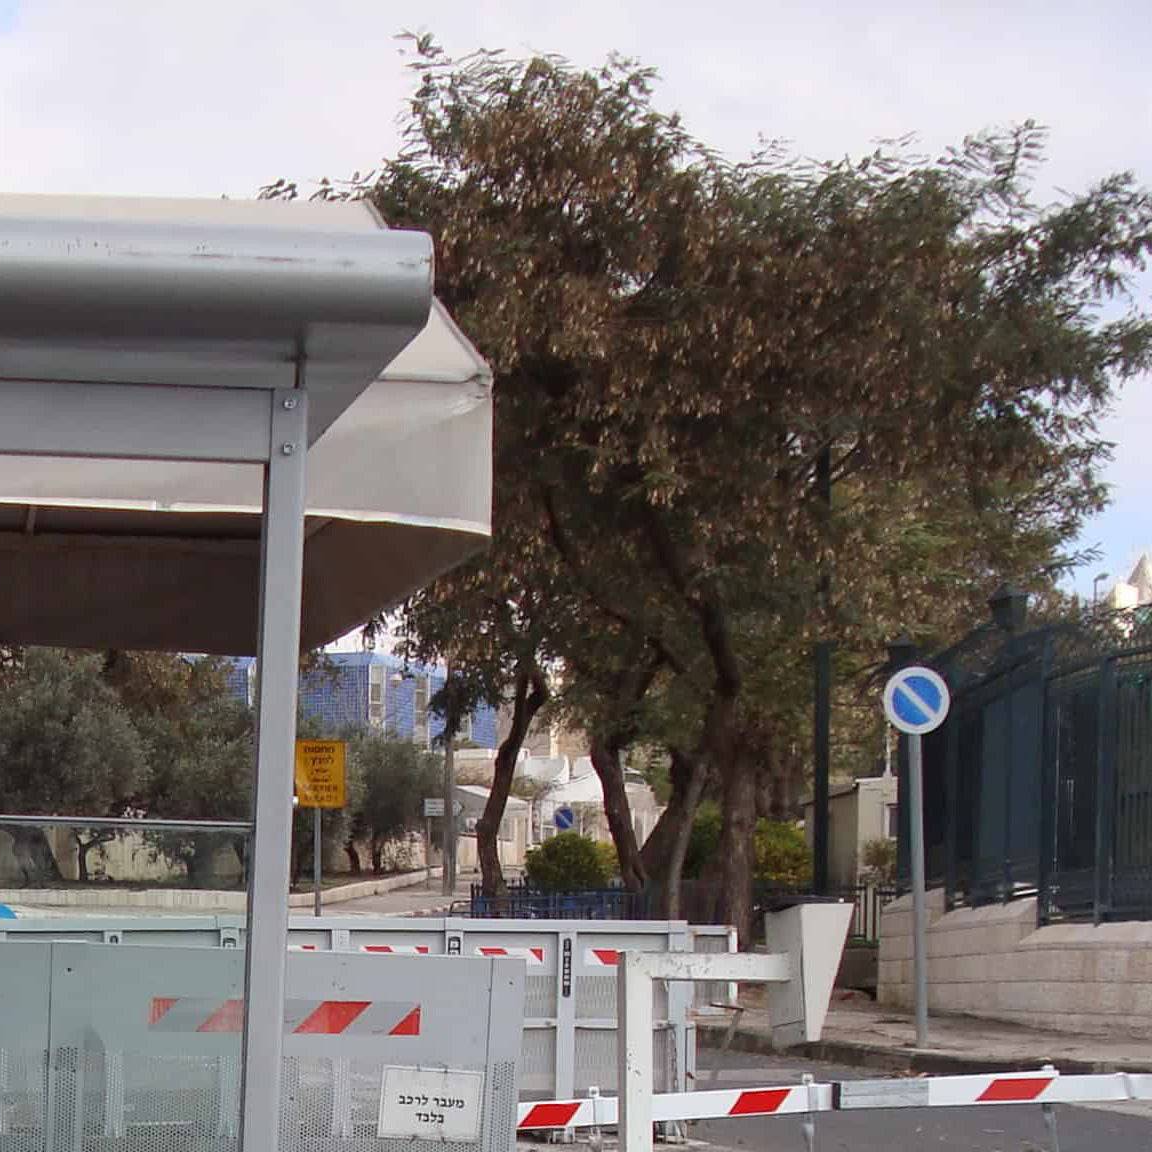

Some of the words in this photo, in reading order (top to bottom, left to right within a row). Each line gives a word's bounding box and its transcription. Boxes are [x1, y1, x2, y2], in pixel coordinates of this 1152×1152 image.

[398, 1094, 429, 1105] לרכב
[432, 1096, 465, 1108] מעבר
[415, 1112, 445, 1123] בלבד
